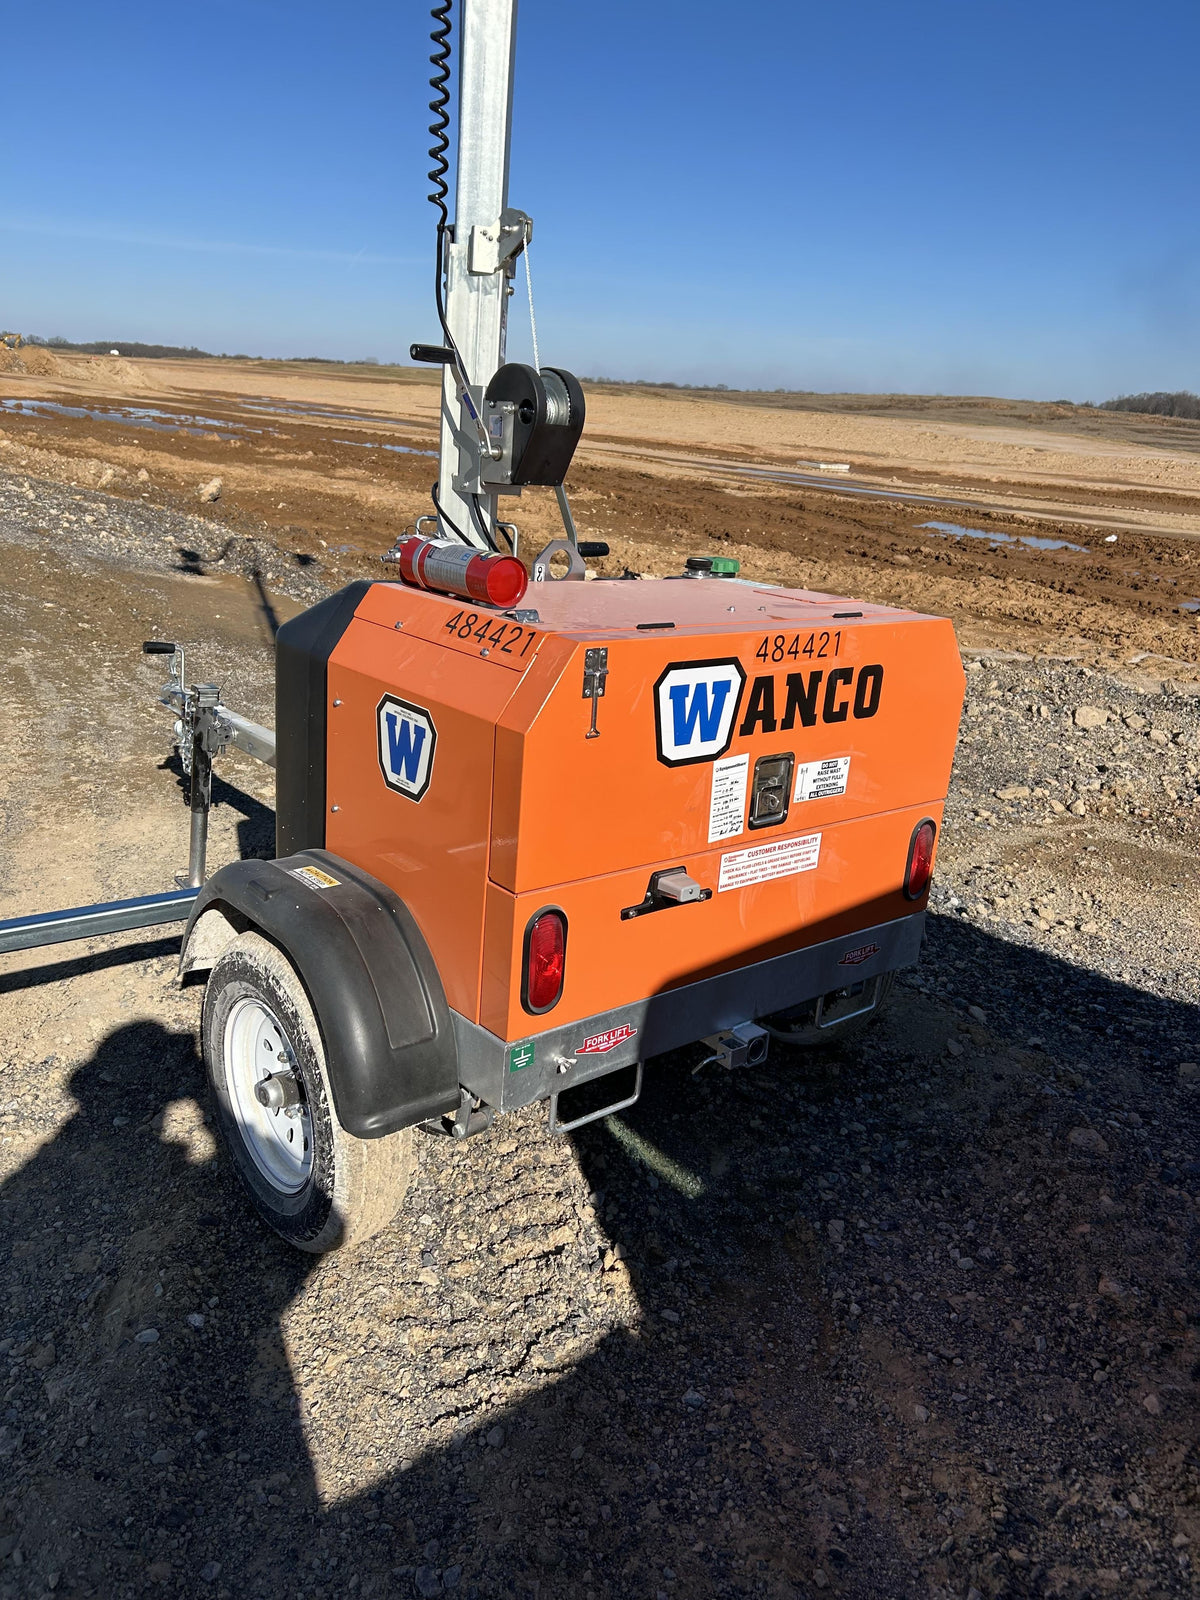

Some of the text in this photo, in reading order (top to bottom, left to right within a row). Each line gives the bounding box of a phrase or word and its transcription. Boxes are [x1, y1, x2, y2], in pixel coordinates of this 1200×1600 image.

[445, 610, 536, 657] 484421
[756, 630, 842, 663] 484421
[668, 663, 884, 747] WANCO
[385, 711, 426, 784] W
[748, 837, 818, 858] CUSTOMER RESPONSIBILITY
[776, 866, 798, 875] MAINTENANCE
[846, 950, 861, 960] FORK
[586, 1034, 609, 1048] FORK
[610, 1028, 627, 1039] LIFT
